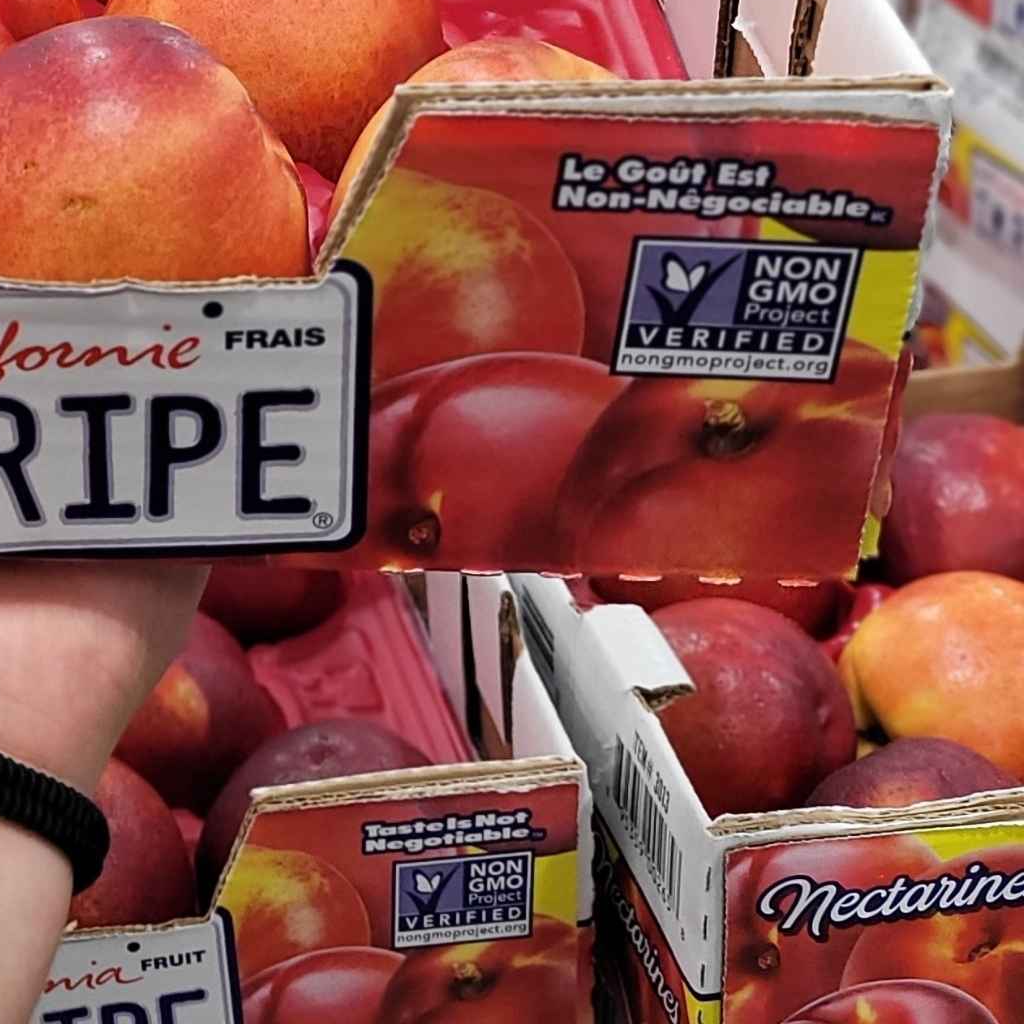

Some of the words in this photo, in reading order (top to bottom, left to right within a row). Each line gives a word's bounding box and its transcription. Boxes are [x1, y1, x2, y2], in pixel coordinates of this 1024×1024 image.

[562, 157, 606, 182] Le
[617, 158, 707, 185] Goût
[716, 162, 771, 187] Est
[754, 255, 842, 281] NON
[748, 280, 837, 305] GMO
[743, 302, 830, 327] Project
[224, 326, 327, 352] FRAIS
[638, 326, 825, 353] VERIFIED
[621, 352, 830, 375] nongmoproject.org
[365, 820, 444, 838] Taste
[446, 817, 473, 830] Is
[475, 812, 530, 827] Not
[364, 827, 530, 853] Negotiable
[469, 858, 524, 878] NON
[468, 874, 524, 893] GMO
[468, 890, 523, 906] Project
[404, 906, 522, 930] VERIFIED
[396, 922, 527, 944] nongmoproject.org
[140, 949, 207, 972] FRUIT
